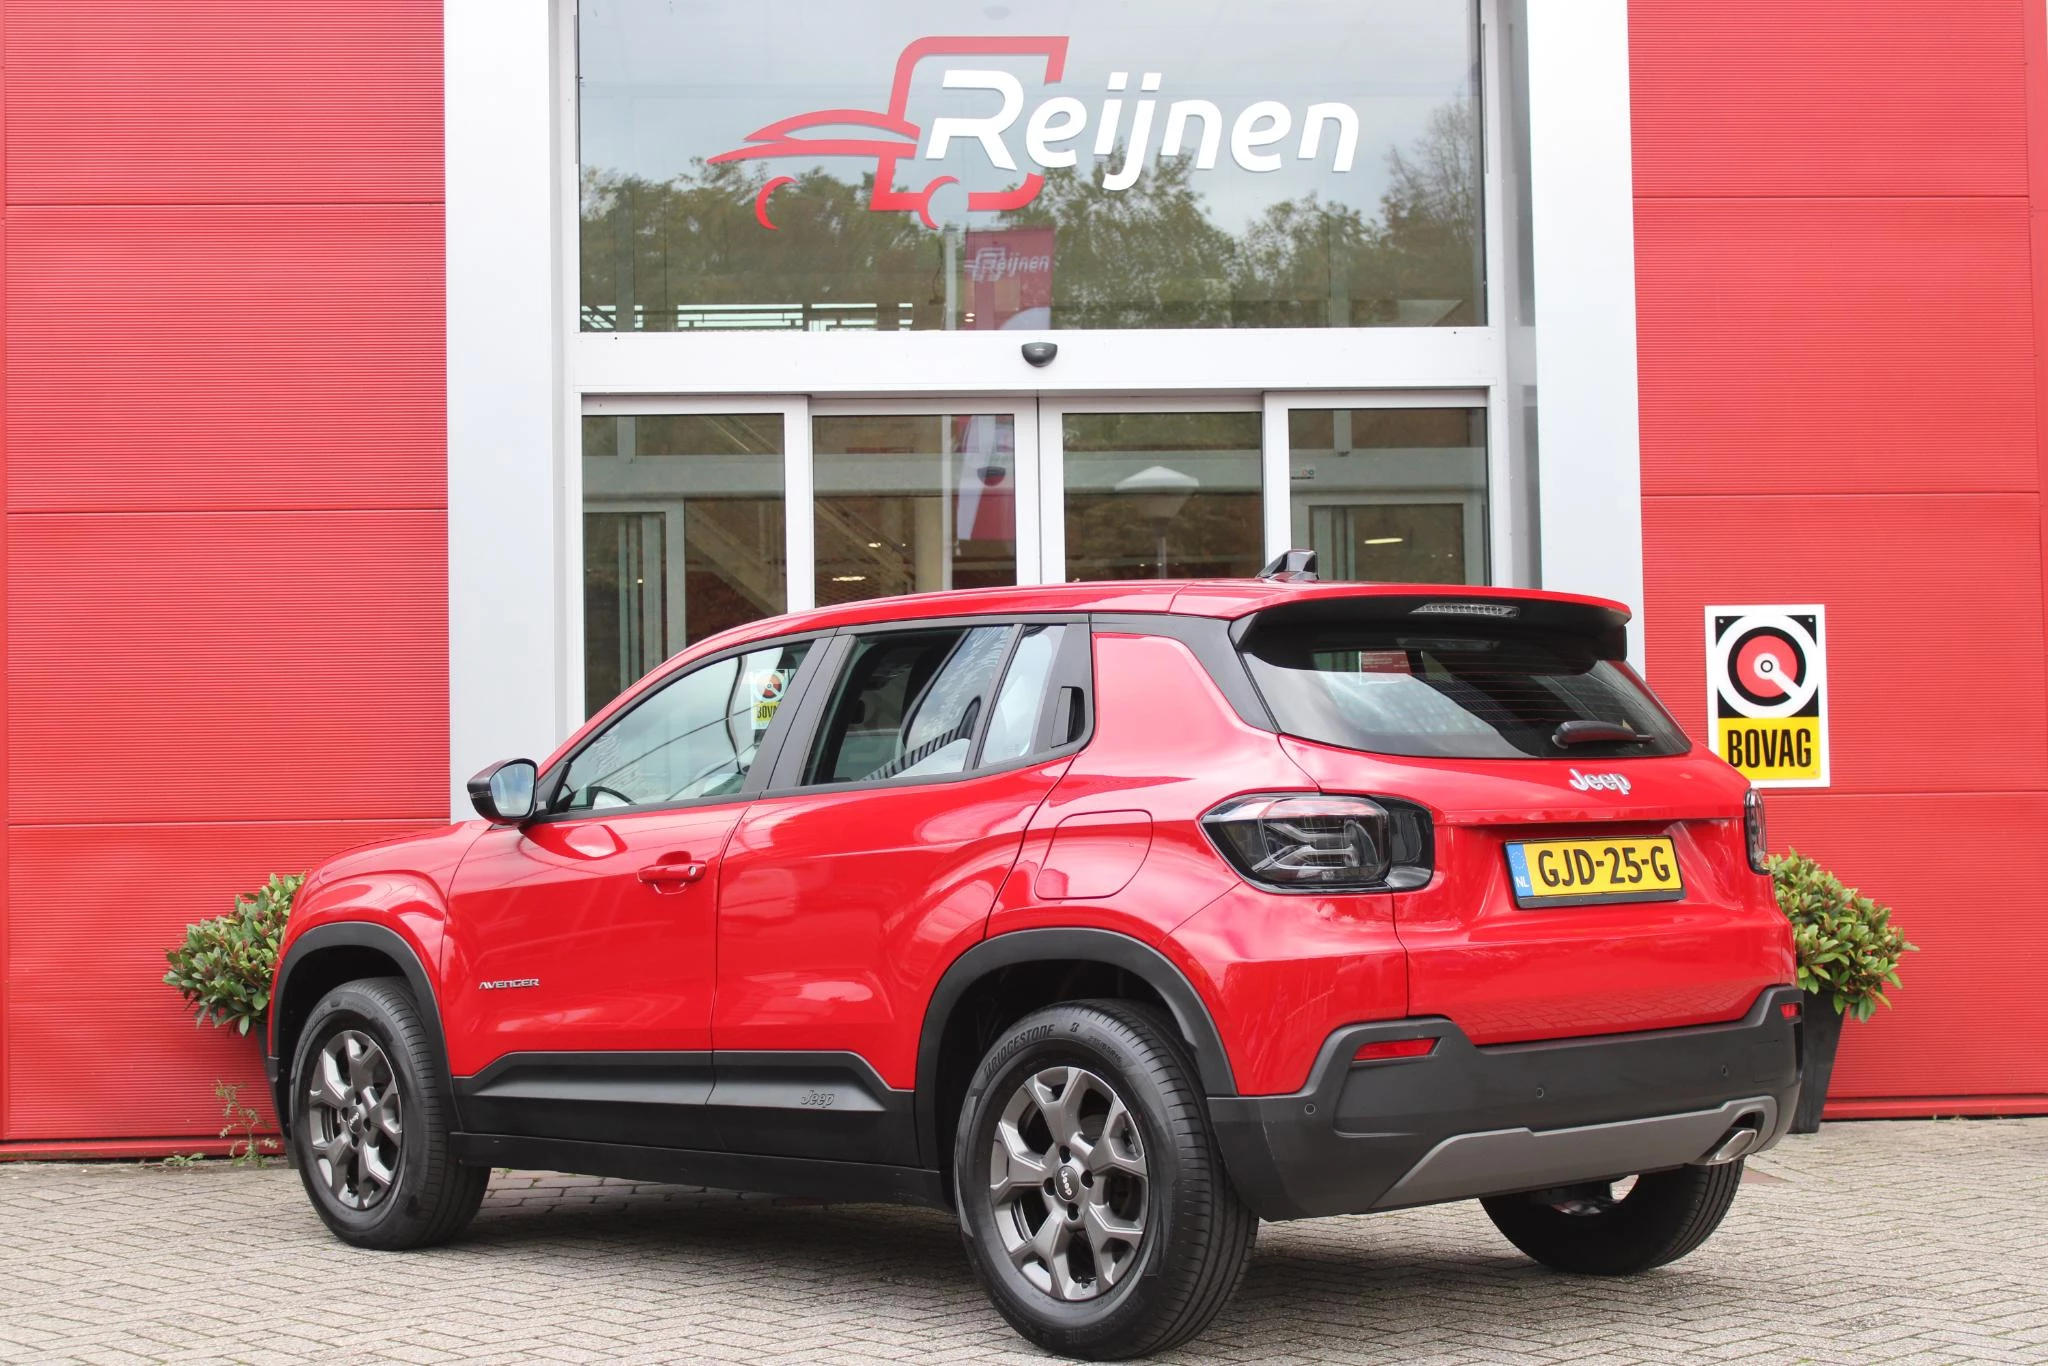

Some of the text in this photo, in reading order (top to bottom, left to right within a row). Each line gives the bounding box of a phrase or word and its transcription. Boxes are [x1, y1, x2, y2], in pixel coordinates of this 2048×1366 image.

[926, 69, 1360, 190] Reijnen
[982, 252, 1050, 278] Reijnen
[1727, 728, 1811, 768] BOVAG
[1569, 768, 1631, 795] Jeep
[1516, 845, 1671, 888] NL GJD-25-G
[478, 978, 540, 990] AVENGER
[984, 1023, 1056, 1081] BRIDGESTONE
[800, 1089, 835, 1109] Jeep
